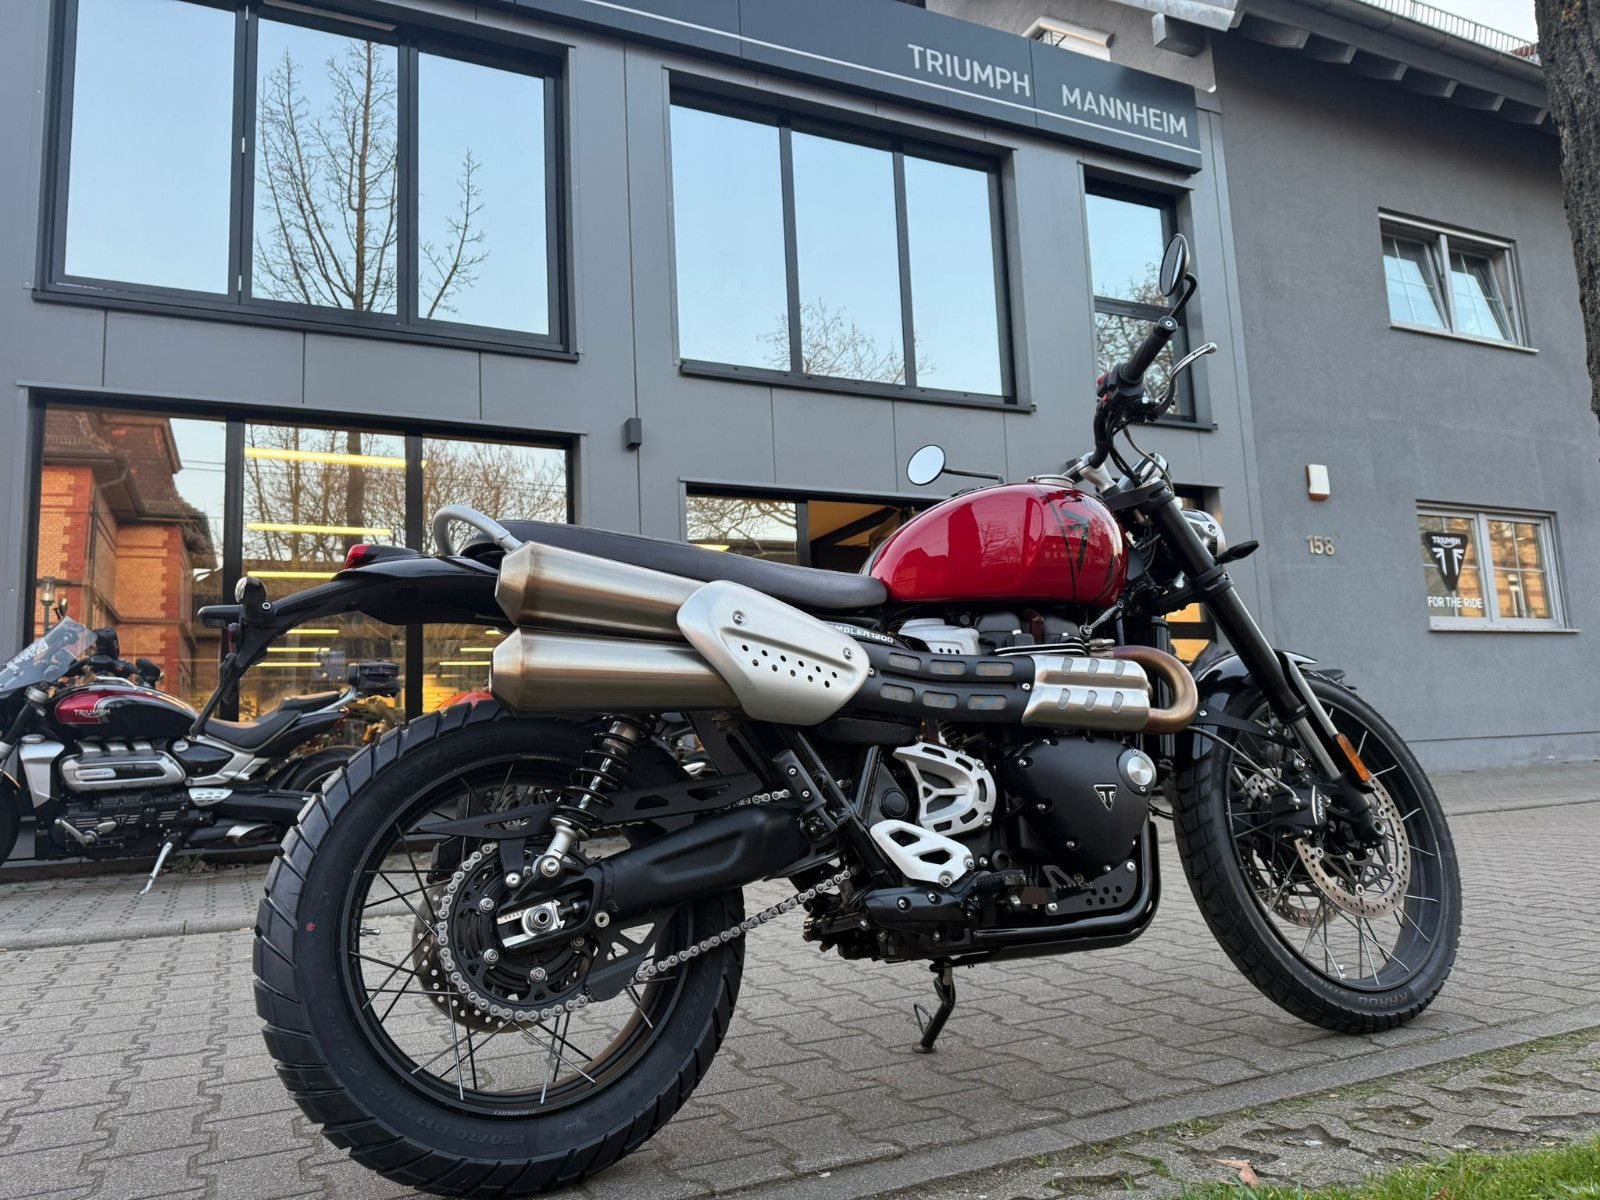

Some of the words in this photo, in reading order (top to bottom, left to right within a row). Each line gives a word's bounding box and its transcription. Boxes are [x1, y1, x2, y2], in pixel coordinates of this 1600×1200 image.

[907, 43, 1030, 97] TRIUMPH
[1061, 84, 1188, 138] MANNHEIM
[1306, 535, 1335, 555] 158
[1431, 535, 1461, 547] TRIUMPH
[1427, 596, 1445, 608] FOR
[1446, 597, 1462, 608] THE
[1464, 597, 1483, 608] RIDE
[870, 632, 894, 643] 1200
[73, 708, 111, 716] TRIUMPH
